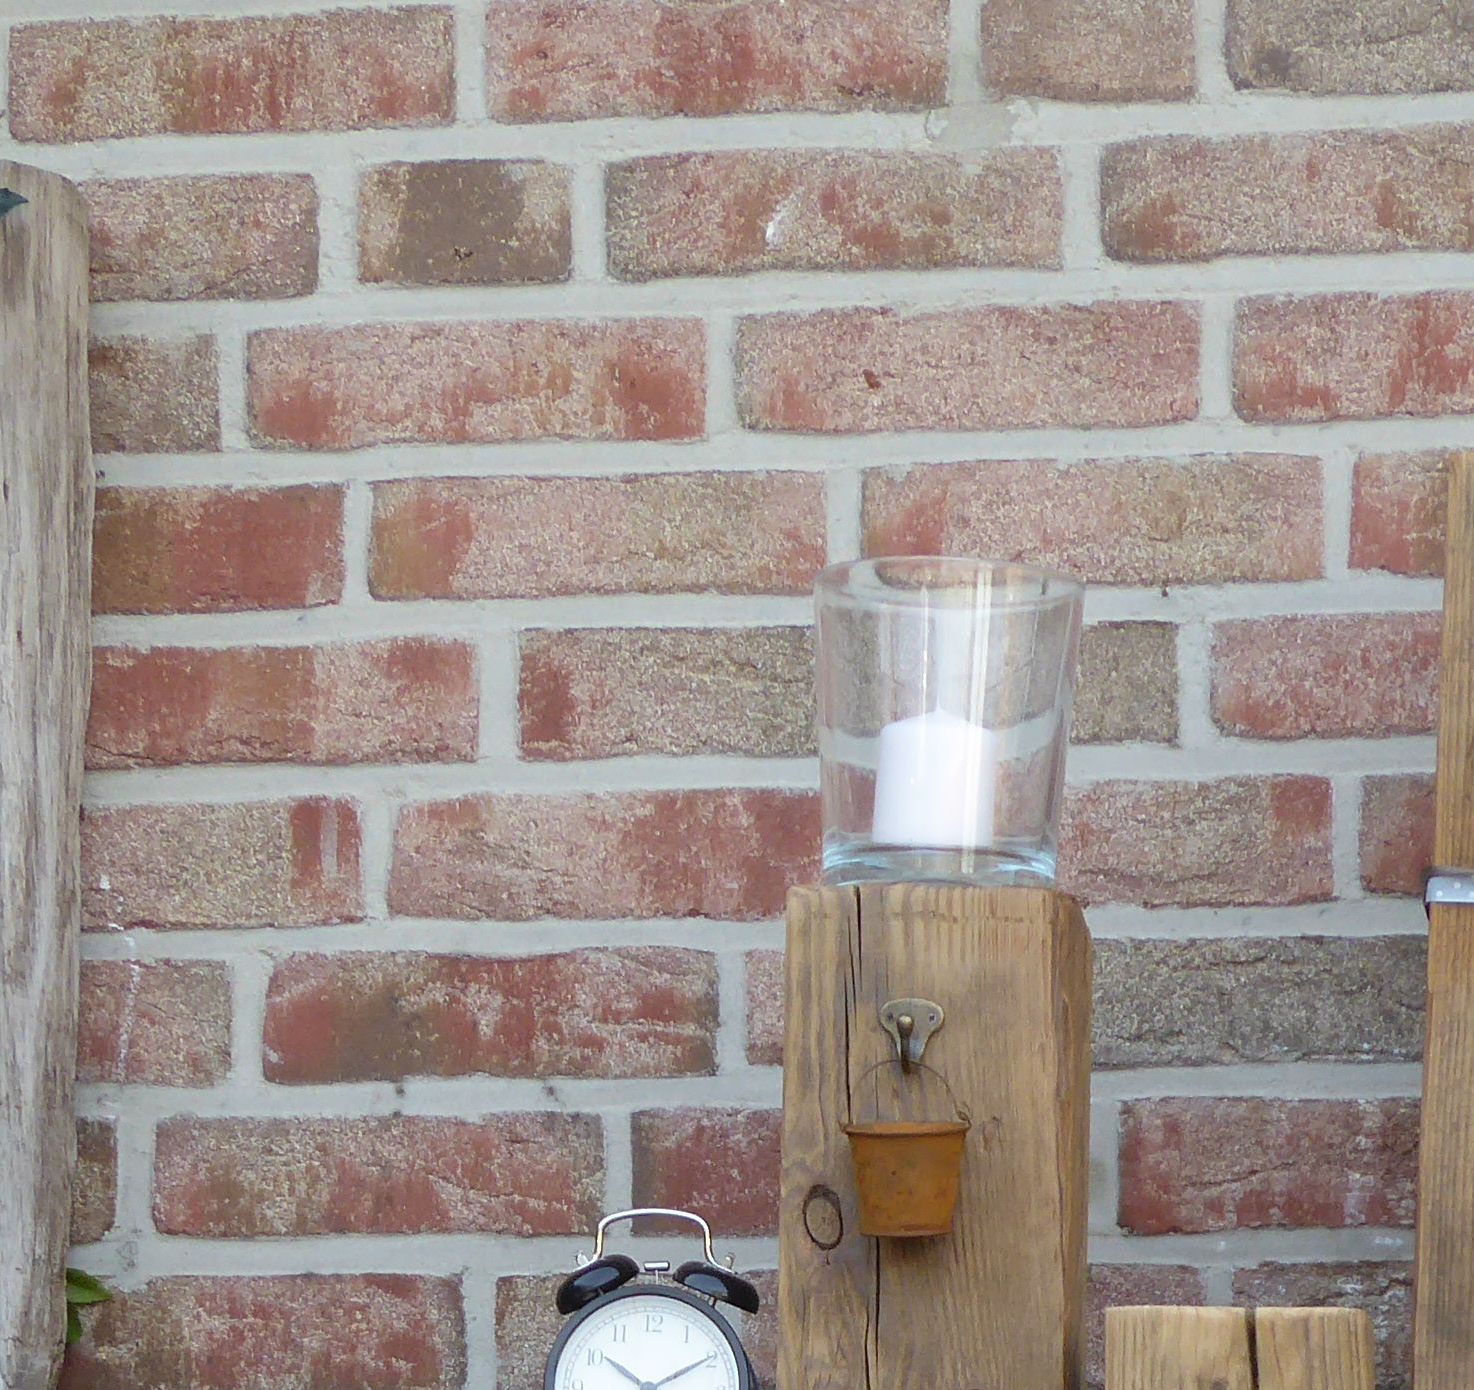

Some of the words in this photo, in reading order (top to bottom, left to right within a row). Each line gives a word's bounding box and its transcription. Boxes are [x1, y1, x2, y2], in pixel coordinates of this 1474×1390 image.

[645, 1314, 663, 1333] 12
[612, 1325, 627, 1343] 11
[684, 1325, 691, 1343] 1
[587, 1349, 603, 1366] 10
[705, 1351, 718, 1368] 2
